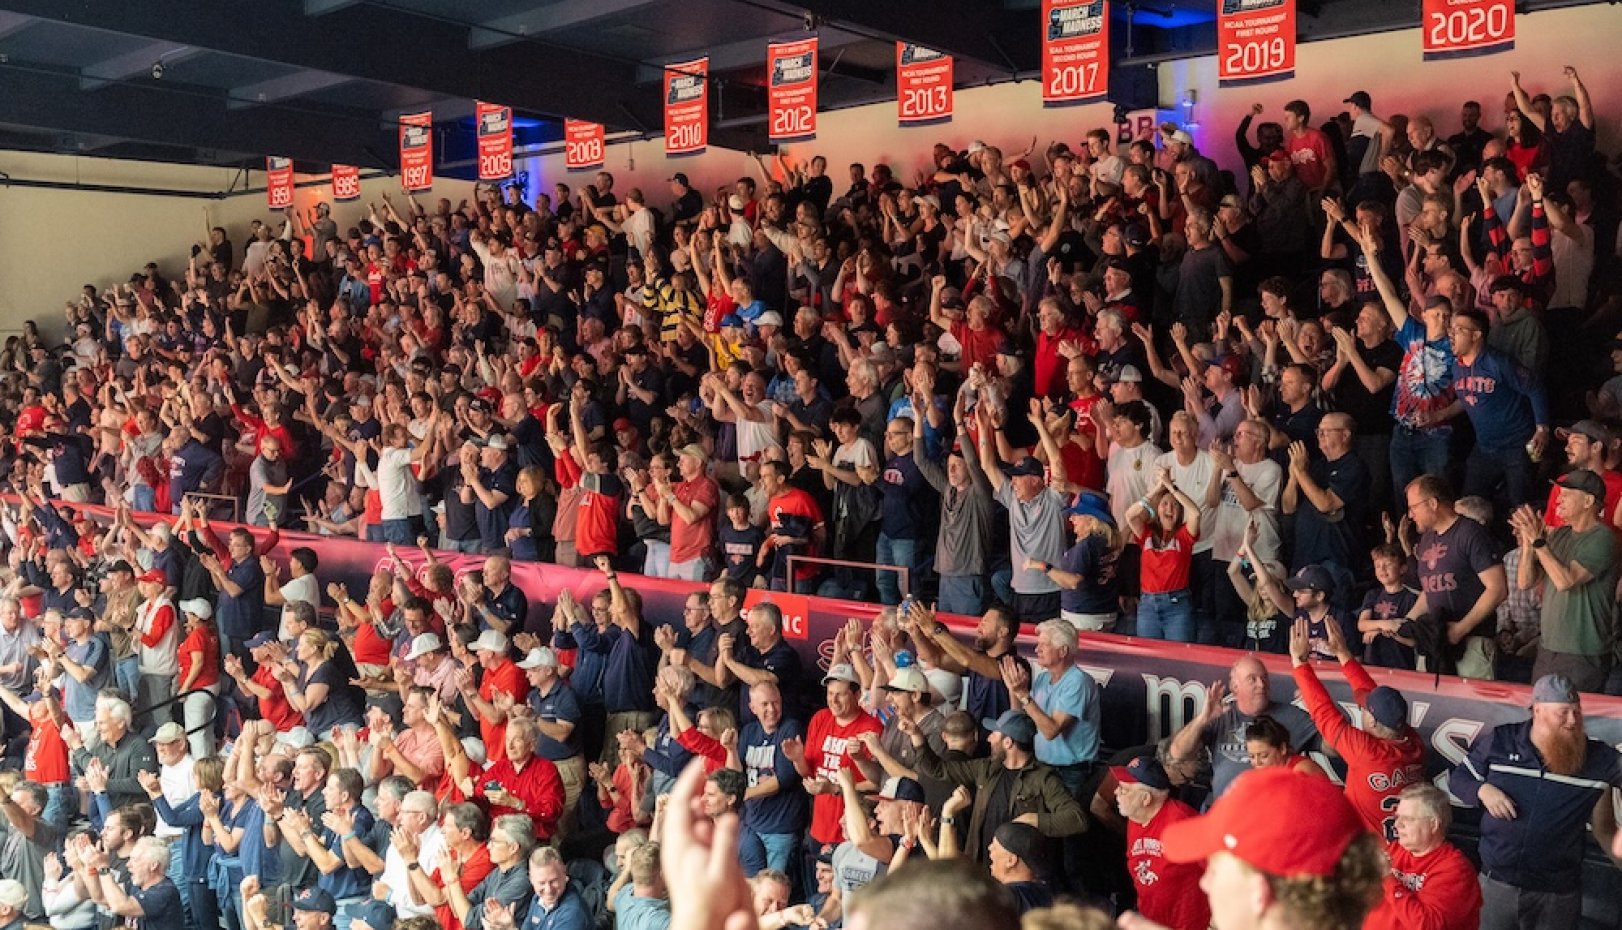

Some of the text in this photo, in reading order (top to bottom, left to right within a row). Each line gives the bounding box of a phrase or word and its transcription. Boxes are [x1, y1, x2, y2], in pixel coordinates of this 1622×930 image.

[1060, 5, 1089, 21] MARCH
[1062, 16, 1102, 33] MADNESS
[1224, 12, 1287, 28] NCAA TOURNAMENT
[1431, 4, 1507, 45] 2020
[1235, 24, 1279, 37] FIRST ROUND
[1226, 36, 1285, 73] 2019
[1051, 62, 1099, 94] 2017
[903, 85, 948, 115] 2013
[774, 105, 812, 133] 2012
[669, 122, 702, 149] 2010
[403, 165, 428, 186] 1997
[481, 153, 512, 176] 2005
